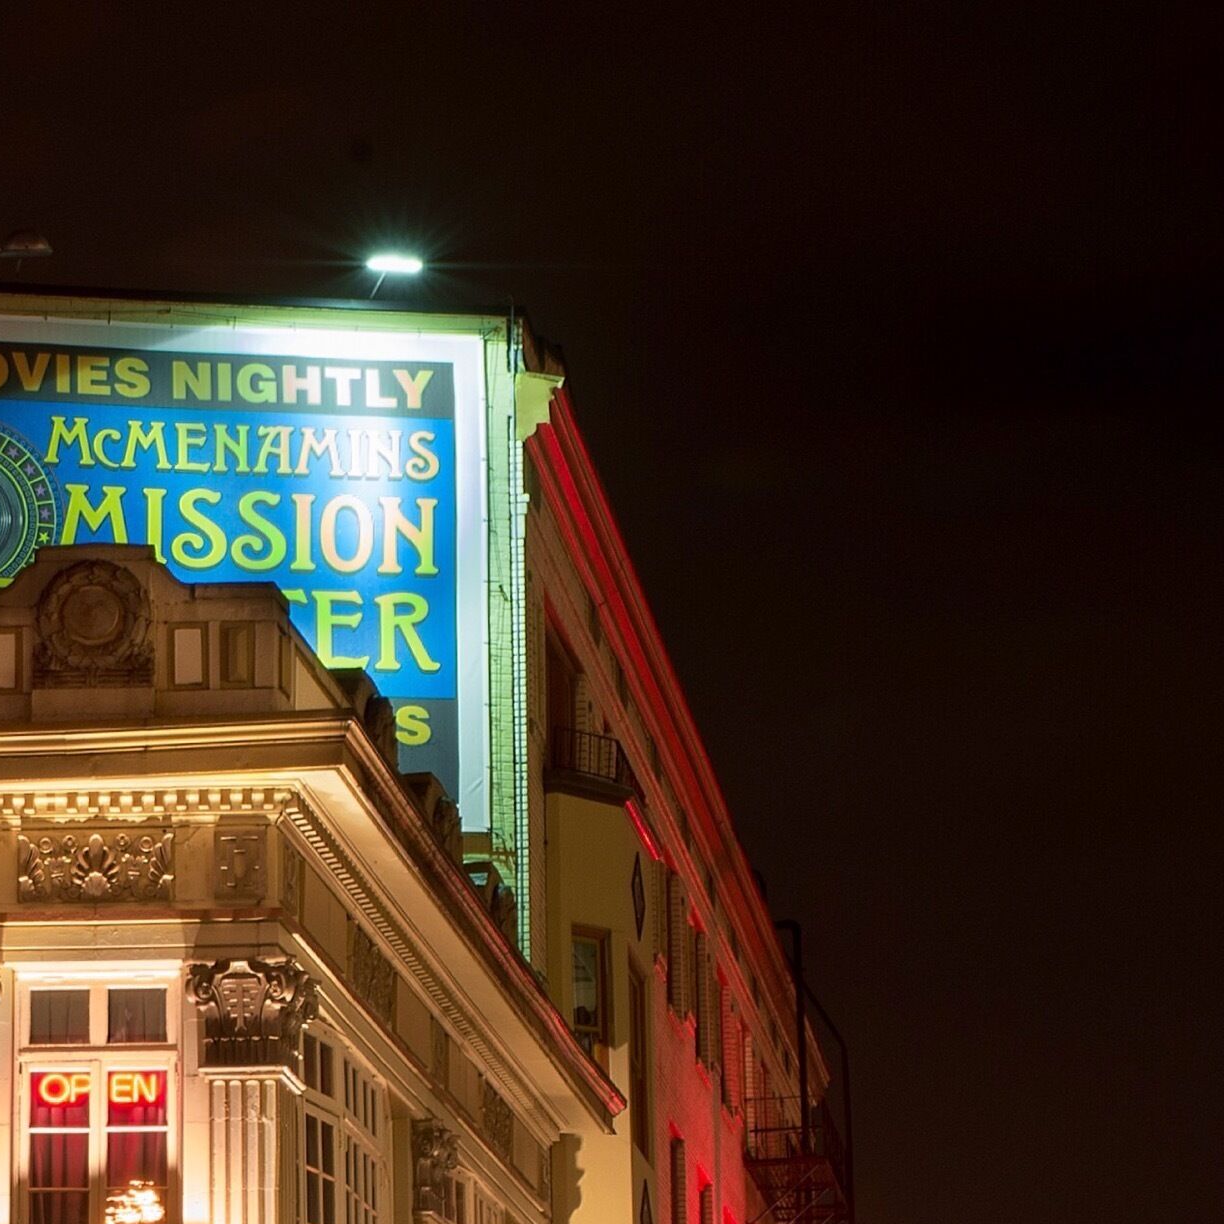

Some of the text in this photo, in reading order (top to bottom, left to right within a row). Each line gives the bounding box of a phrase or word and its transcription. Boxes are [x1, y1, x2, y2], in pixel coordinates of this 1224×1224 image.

[171, 361, 434, 409] NIGHTLY
[63, 484, 439, 576] MISSION
[39, 1072, 160, 1105] OPEN
